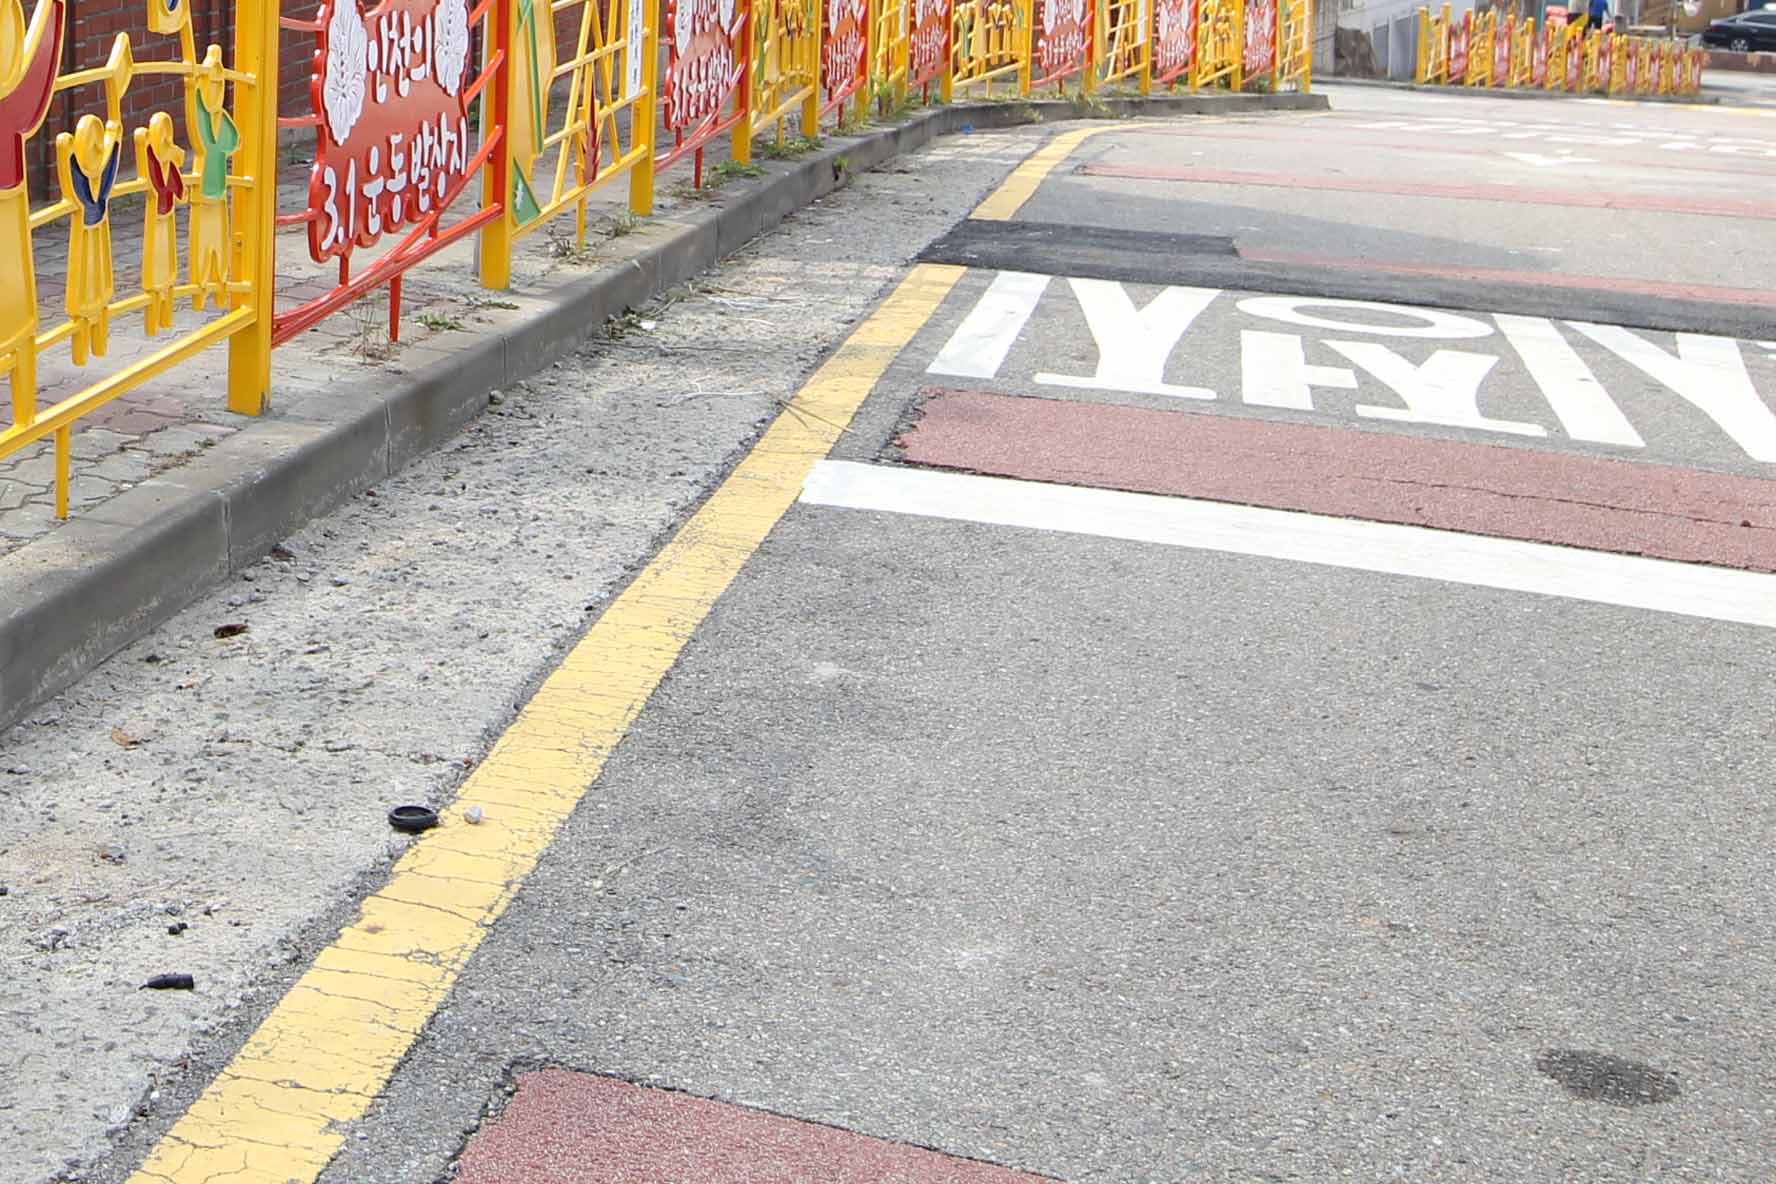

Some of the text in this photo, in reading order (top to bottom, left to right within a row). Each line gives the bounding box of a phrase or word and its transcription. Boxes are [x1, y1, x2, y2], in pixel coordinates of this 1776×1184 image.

[368, 10, 433, 105] 인천의
[411, 112, 468, 212] 발상지
[926, 269, 1776, 464] 시정지
